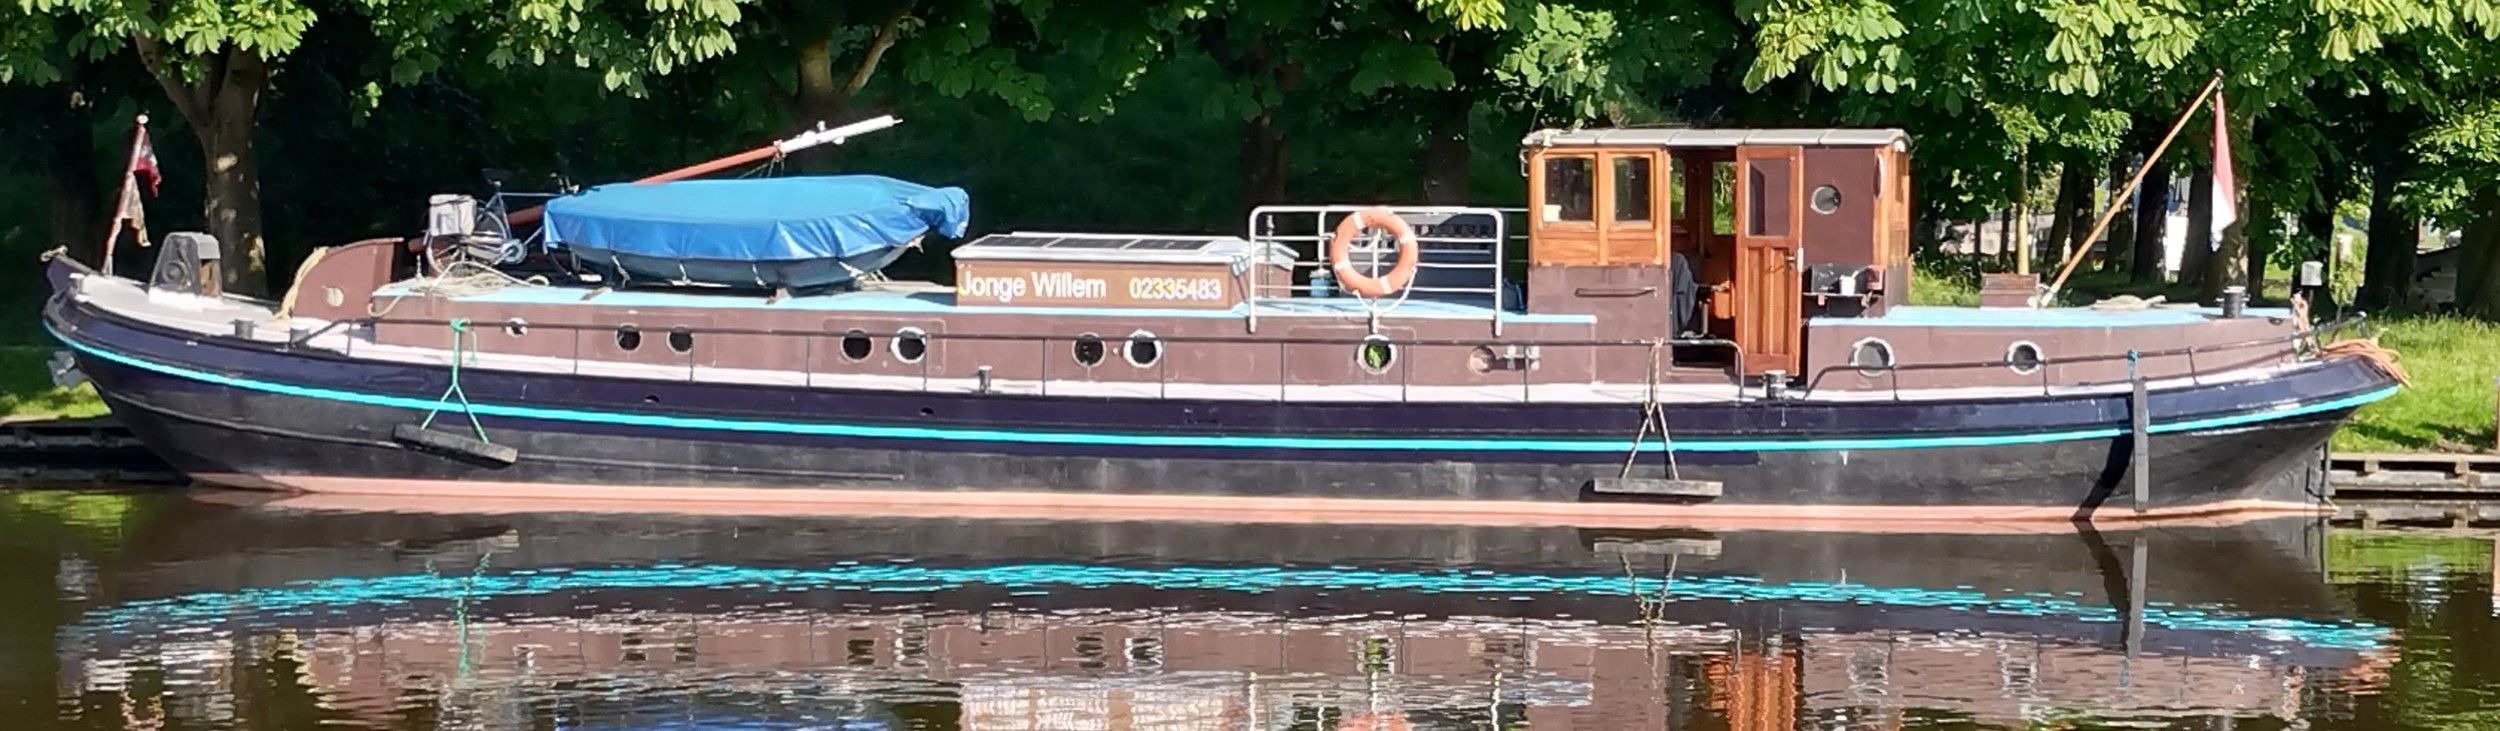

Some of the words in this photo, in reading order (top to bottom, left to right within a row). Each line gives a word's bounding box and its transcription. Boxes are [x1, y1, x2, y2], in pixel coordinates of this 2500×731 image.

[959, 270, 1026, 302] Jonge
[1031, 271, 1107, 299] Willem
[1129, 276, 1222, 301] 02335483
